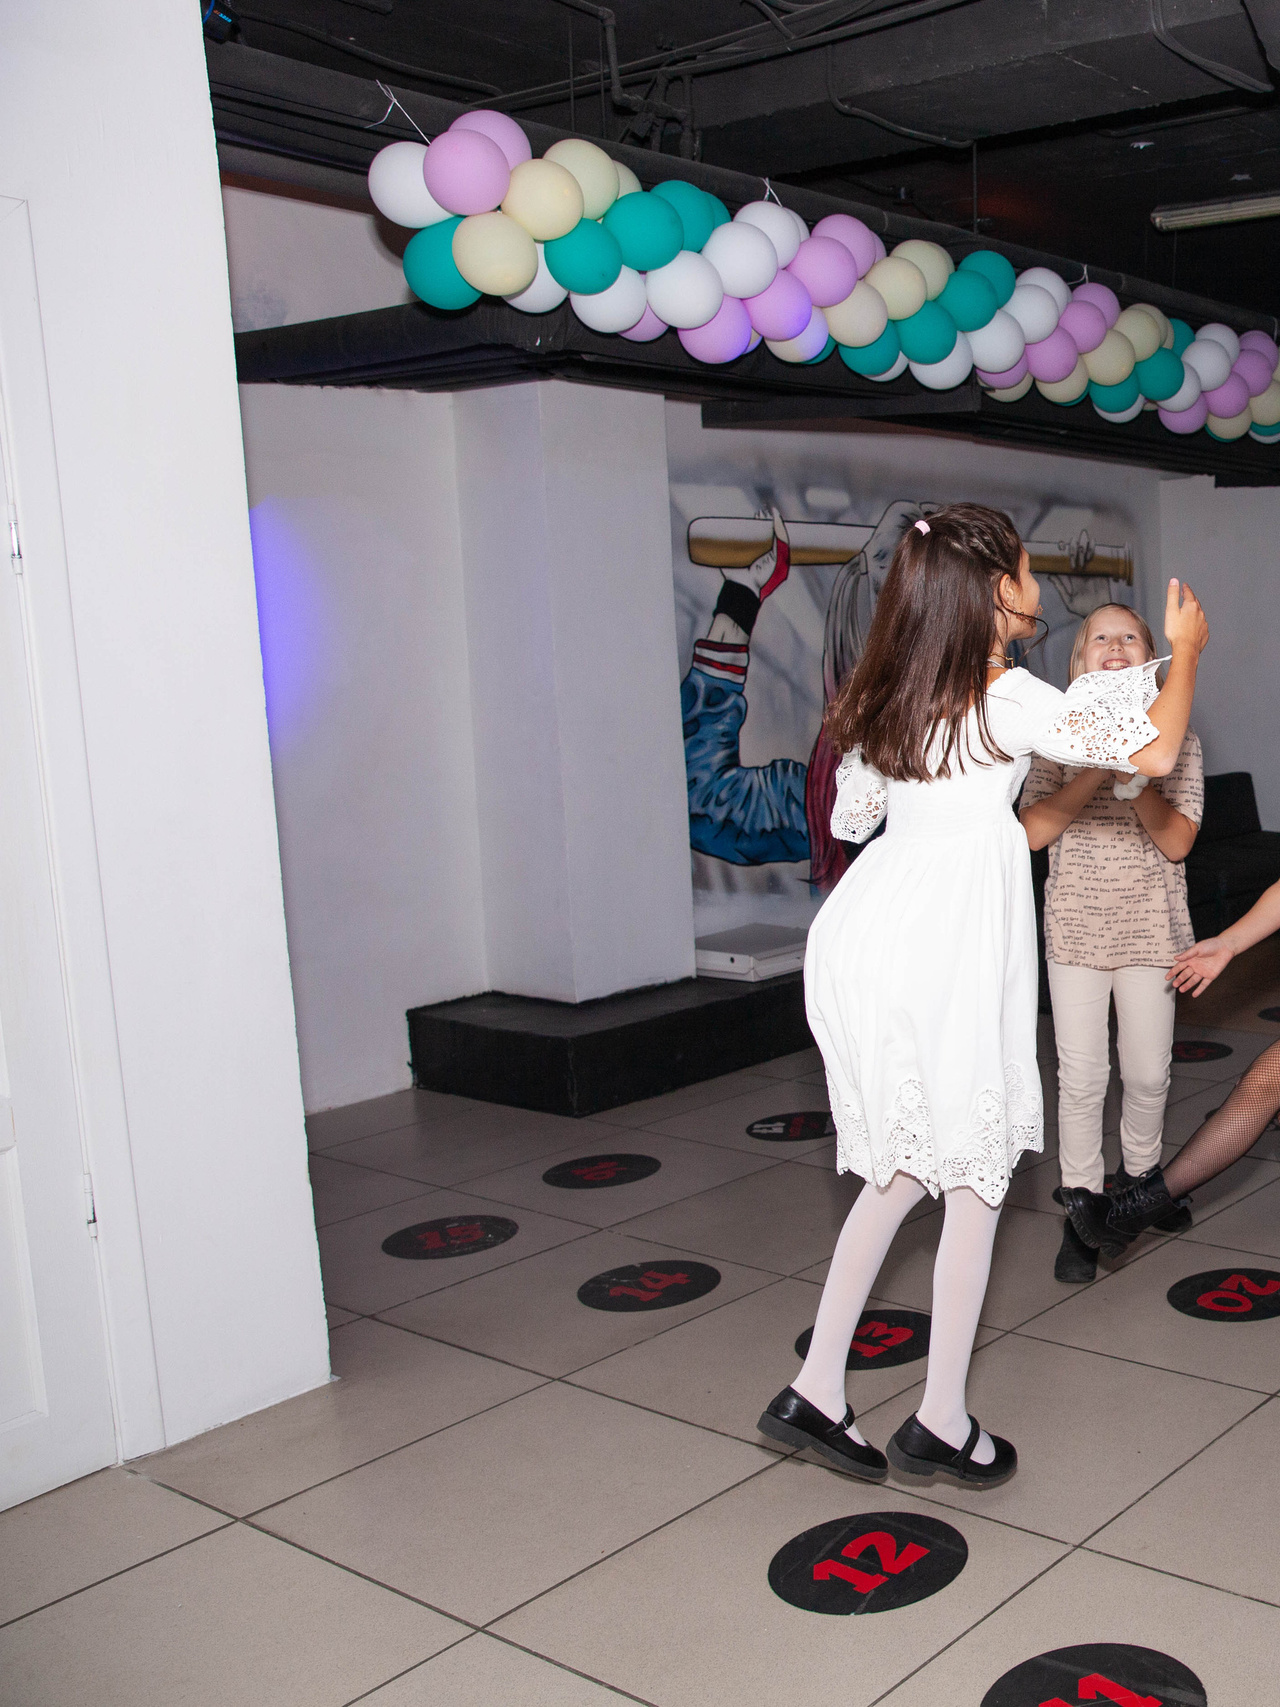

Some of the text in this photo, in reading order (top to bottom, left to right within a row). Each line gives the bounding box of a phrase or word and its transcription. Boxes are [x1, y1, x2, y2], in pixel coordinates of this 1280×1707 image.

[414, 1223, 485, 1250] 15
[609, 1270, 692, 1302] 14
[813, 1530, 931, 1595] 12
[1038, 1672, 1164, 1707] 1
